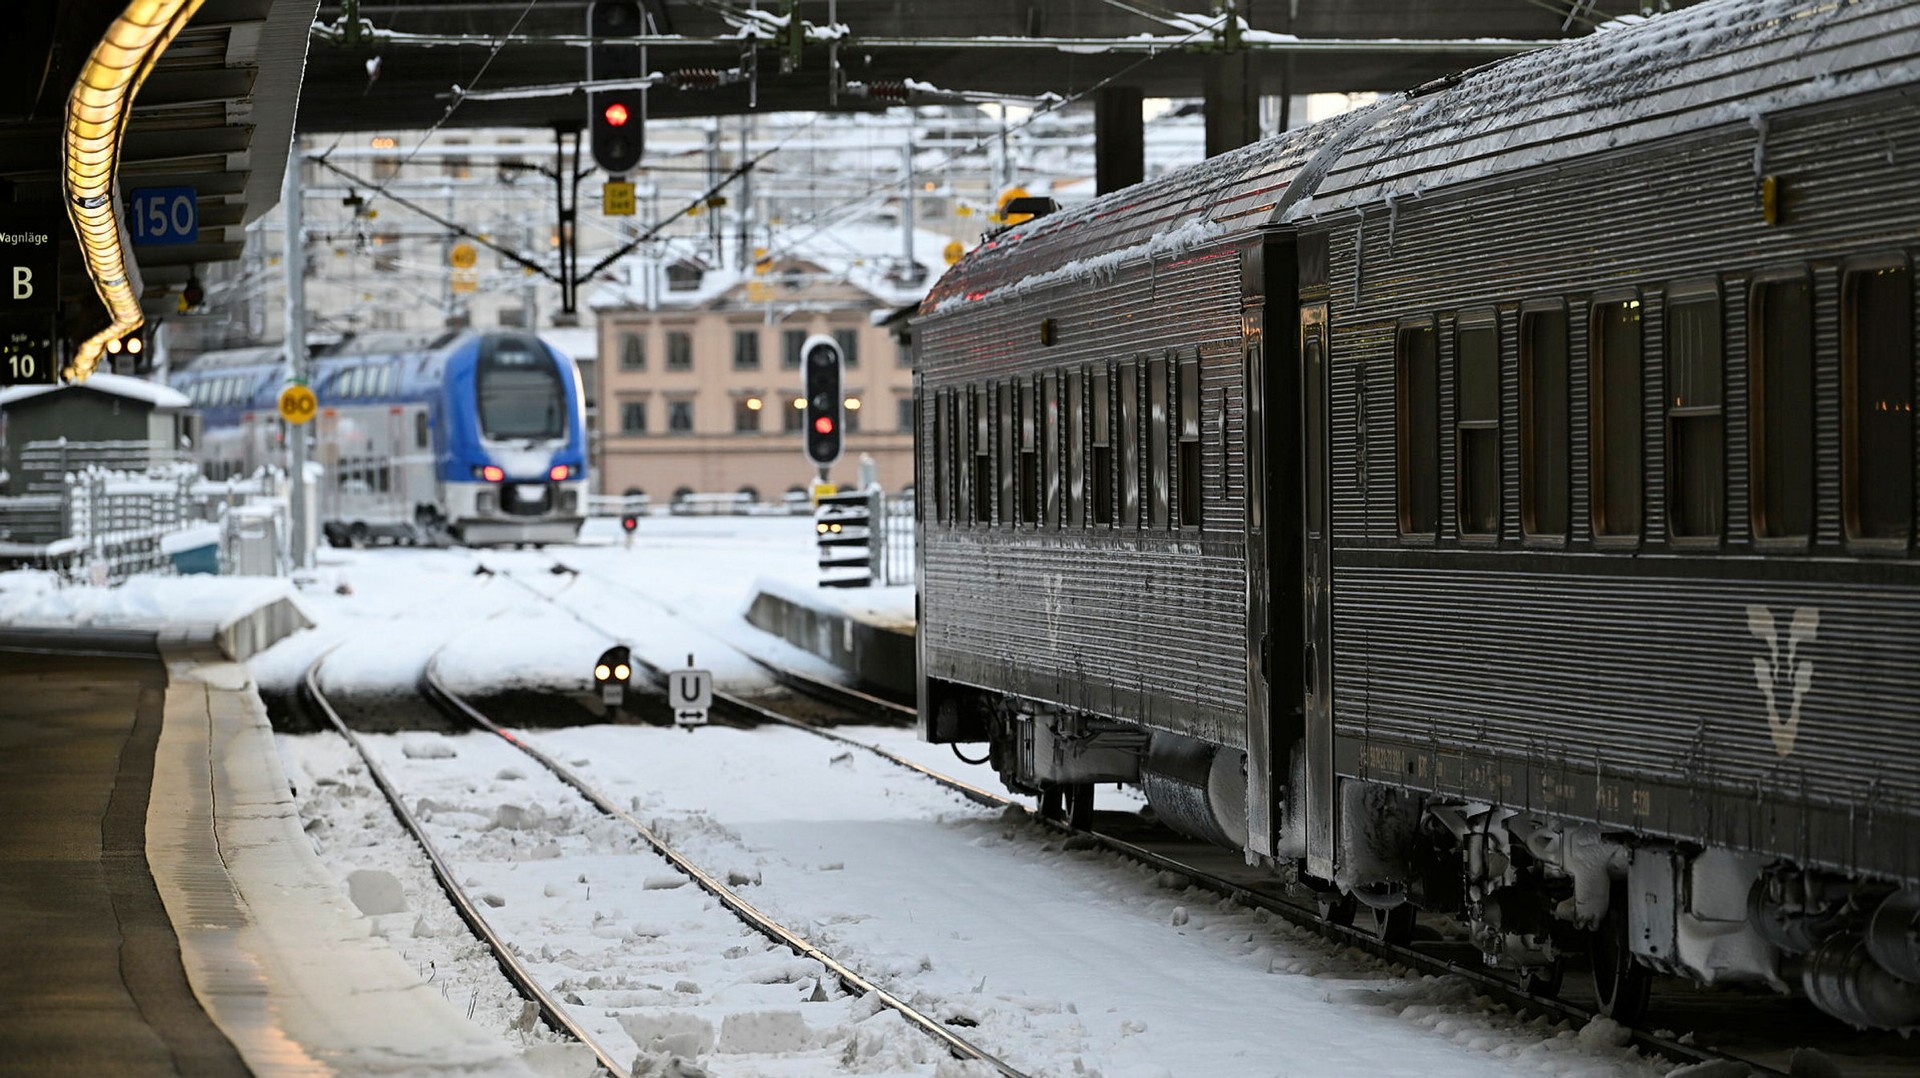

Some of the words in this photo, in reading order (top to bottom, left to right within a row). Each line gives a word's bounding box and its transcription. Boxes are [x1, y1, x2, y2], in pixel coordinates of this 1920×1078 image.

[134, 195, 194, 237] 150
[13, 266, 34, 300] B
[8, 354, 35, 379] 10
[282, 394, 314, 415] 80
[681, 676, 700, 702] U
